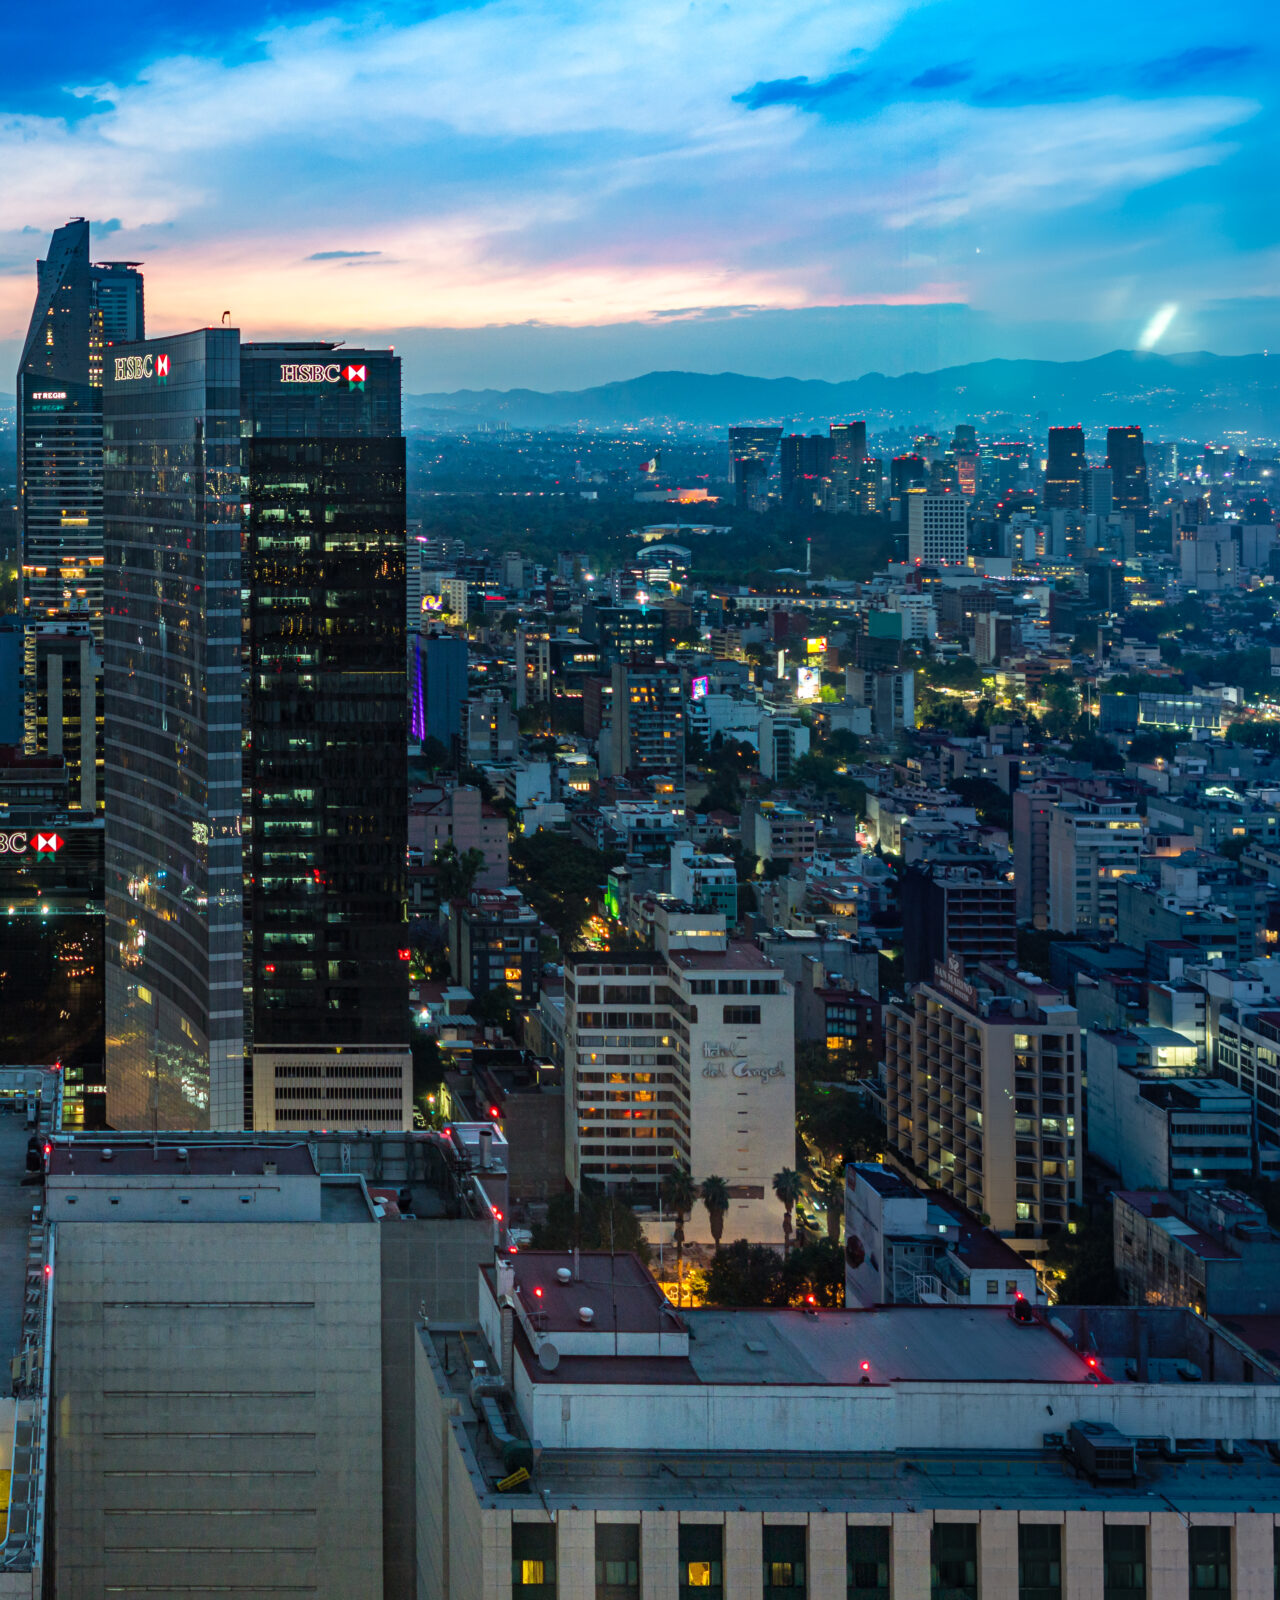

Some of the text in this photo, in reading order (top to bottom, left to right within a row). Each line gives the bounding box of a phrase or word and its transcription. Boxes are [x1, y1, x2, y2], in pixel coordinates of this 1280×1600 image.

[114, 354, 153, 381] HSBC
[280, 363, 341, 383] HSBC
[42, 391, 67, 399] REGIS
